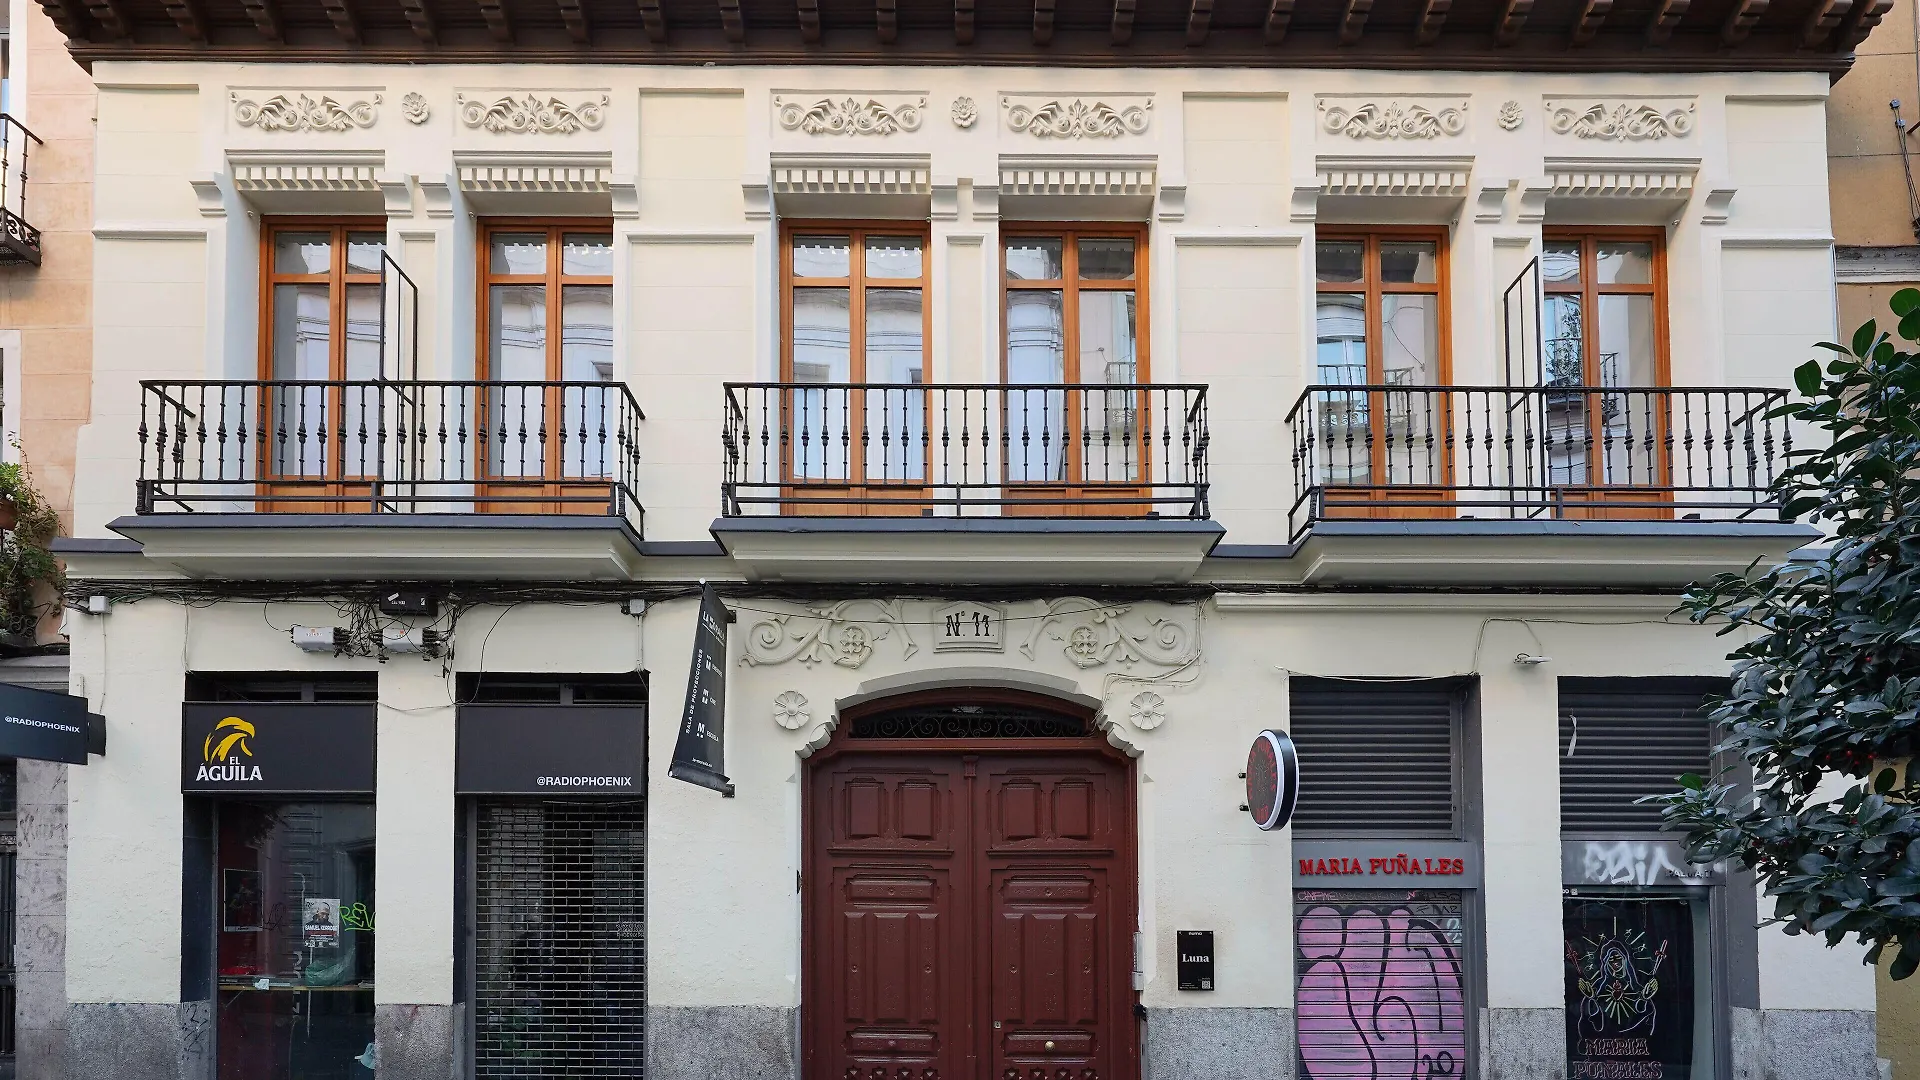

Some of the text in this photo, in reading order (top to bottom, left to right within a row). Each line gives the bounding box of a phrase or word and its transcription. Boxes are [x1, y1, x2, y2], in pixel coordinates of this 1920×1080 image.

[4, 715, 81, 734] @RADIOPHOENIX
[229, 756, 241, 765] EL
[195, 762, 264, 781] ÁGUILA
[537, 776, 632, 787] @RADIOPHOENIX
[1299, 853, 1464, 876] MARIA PUÑALES
[1181, 953, 1210, 963] Luna
